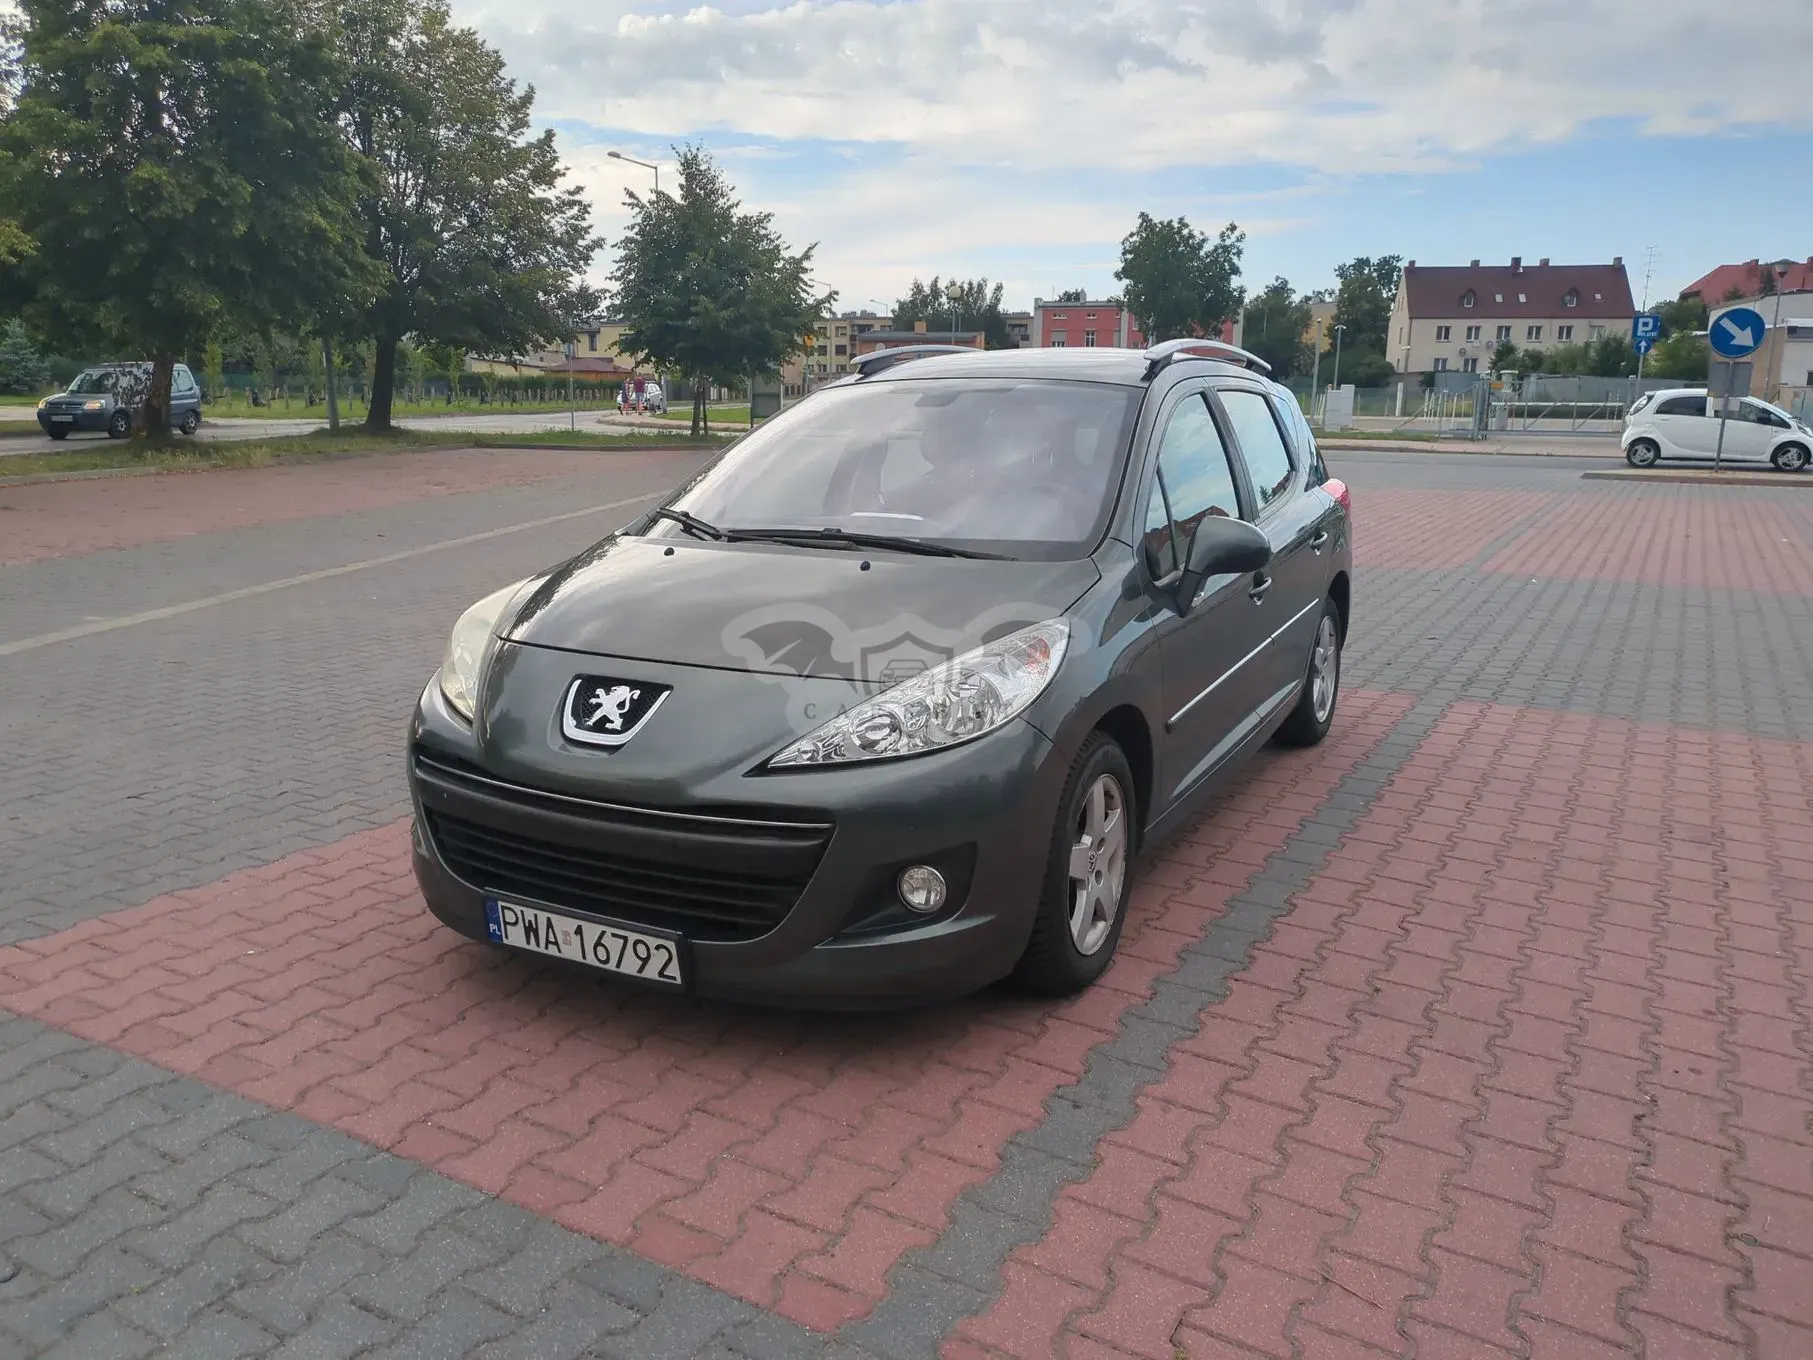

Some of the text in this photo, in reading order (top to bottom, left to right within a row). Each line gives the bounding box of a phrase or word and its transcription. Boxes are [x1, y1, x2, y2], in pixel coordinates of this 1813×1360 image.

[1637, 317, 1654, 337] P
[489, 923, 502, 935] PL
[500, 904, 678, 982] PWA 16792
